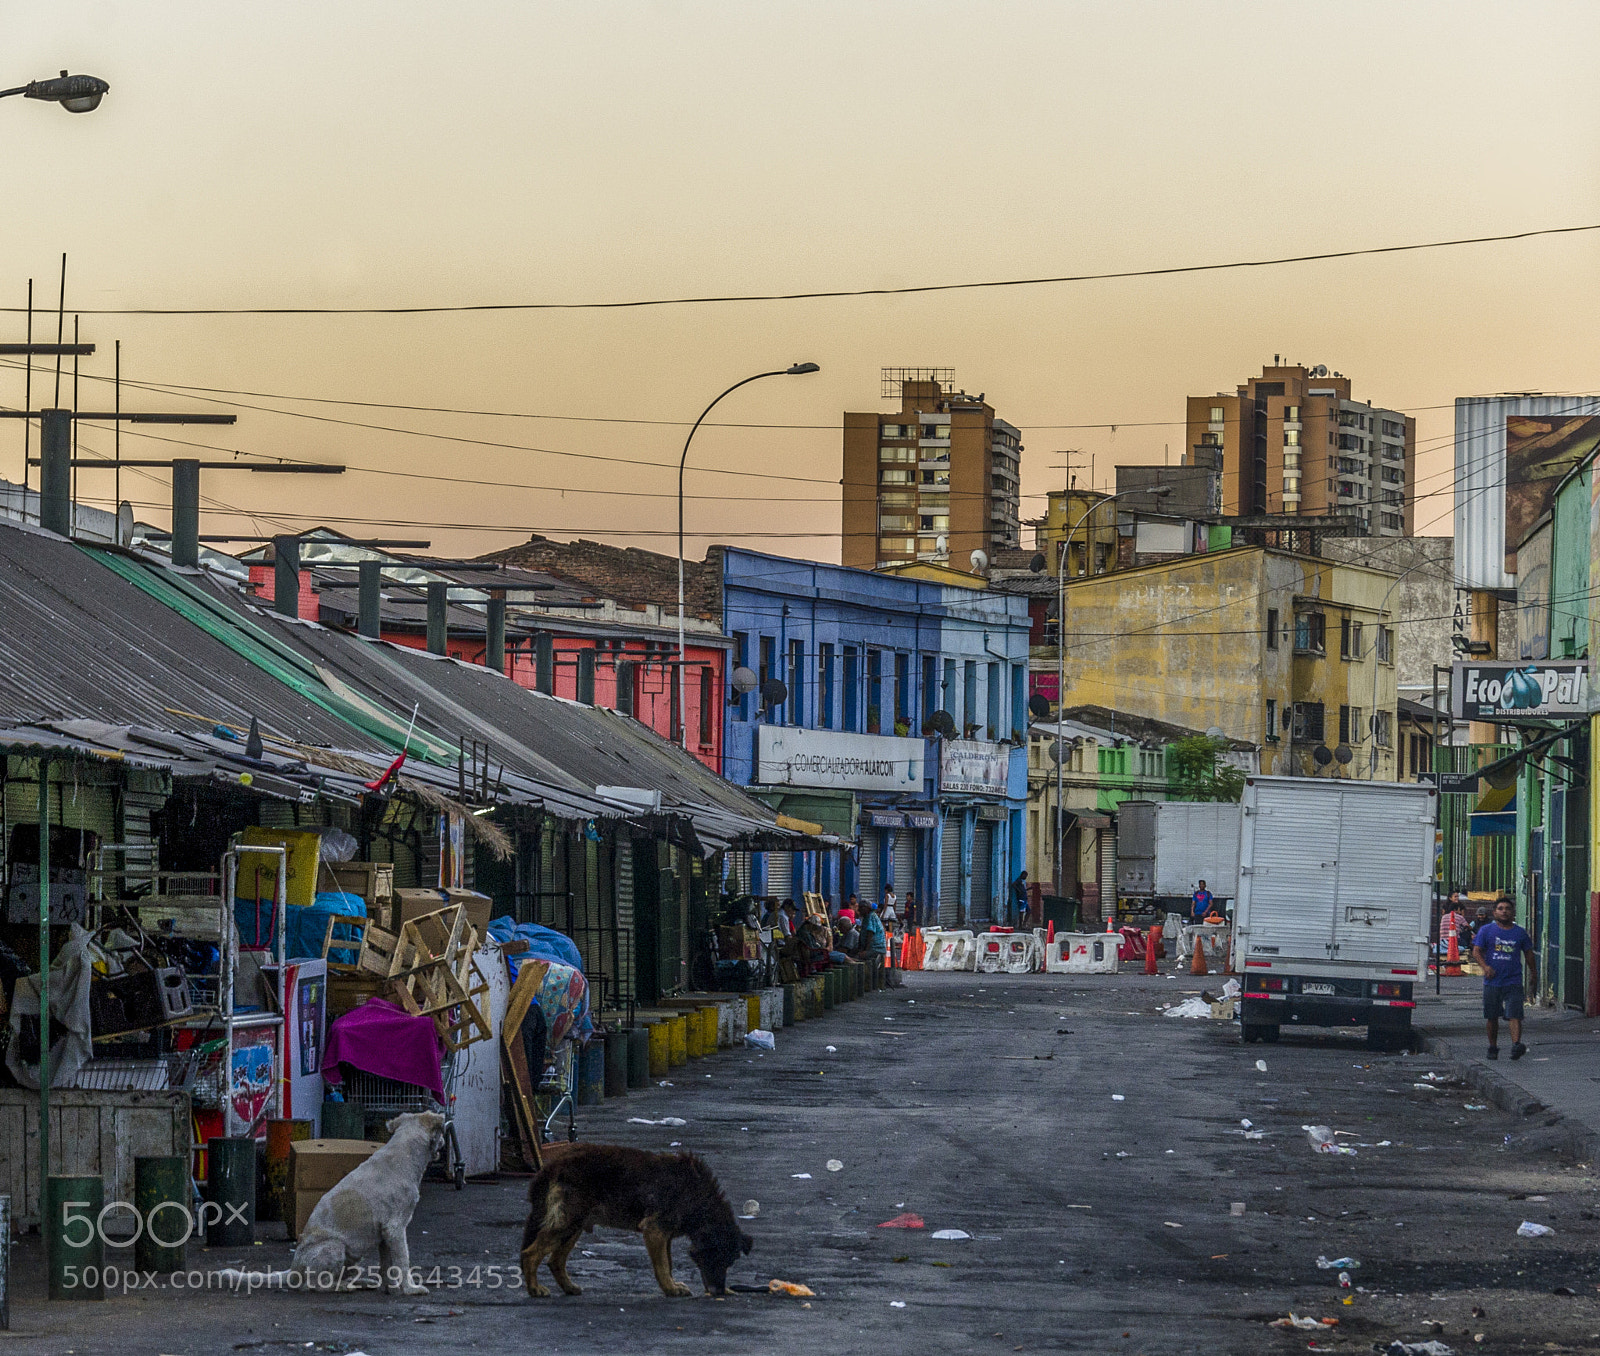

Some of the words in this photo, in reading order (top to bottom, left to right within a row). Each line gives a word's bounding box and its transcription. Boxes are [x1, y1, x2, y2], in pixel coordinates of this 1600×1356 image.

[1466, 669, 1502, 703] Eco
[1541, 666, 1582, 704] Pal
[1495, 708, 1549, 716] DISTRIBUIDORES
[795, 753, 864, 776] COMERCIALIZADORA
[864, 759, 894, 777] ALARCON
